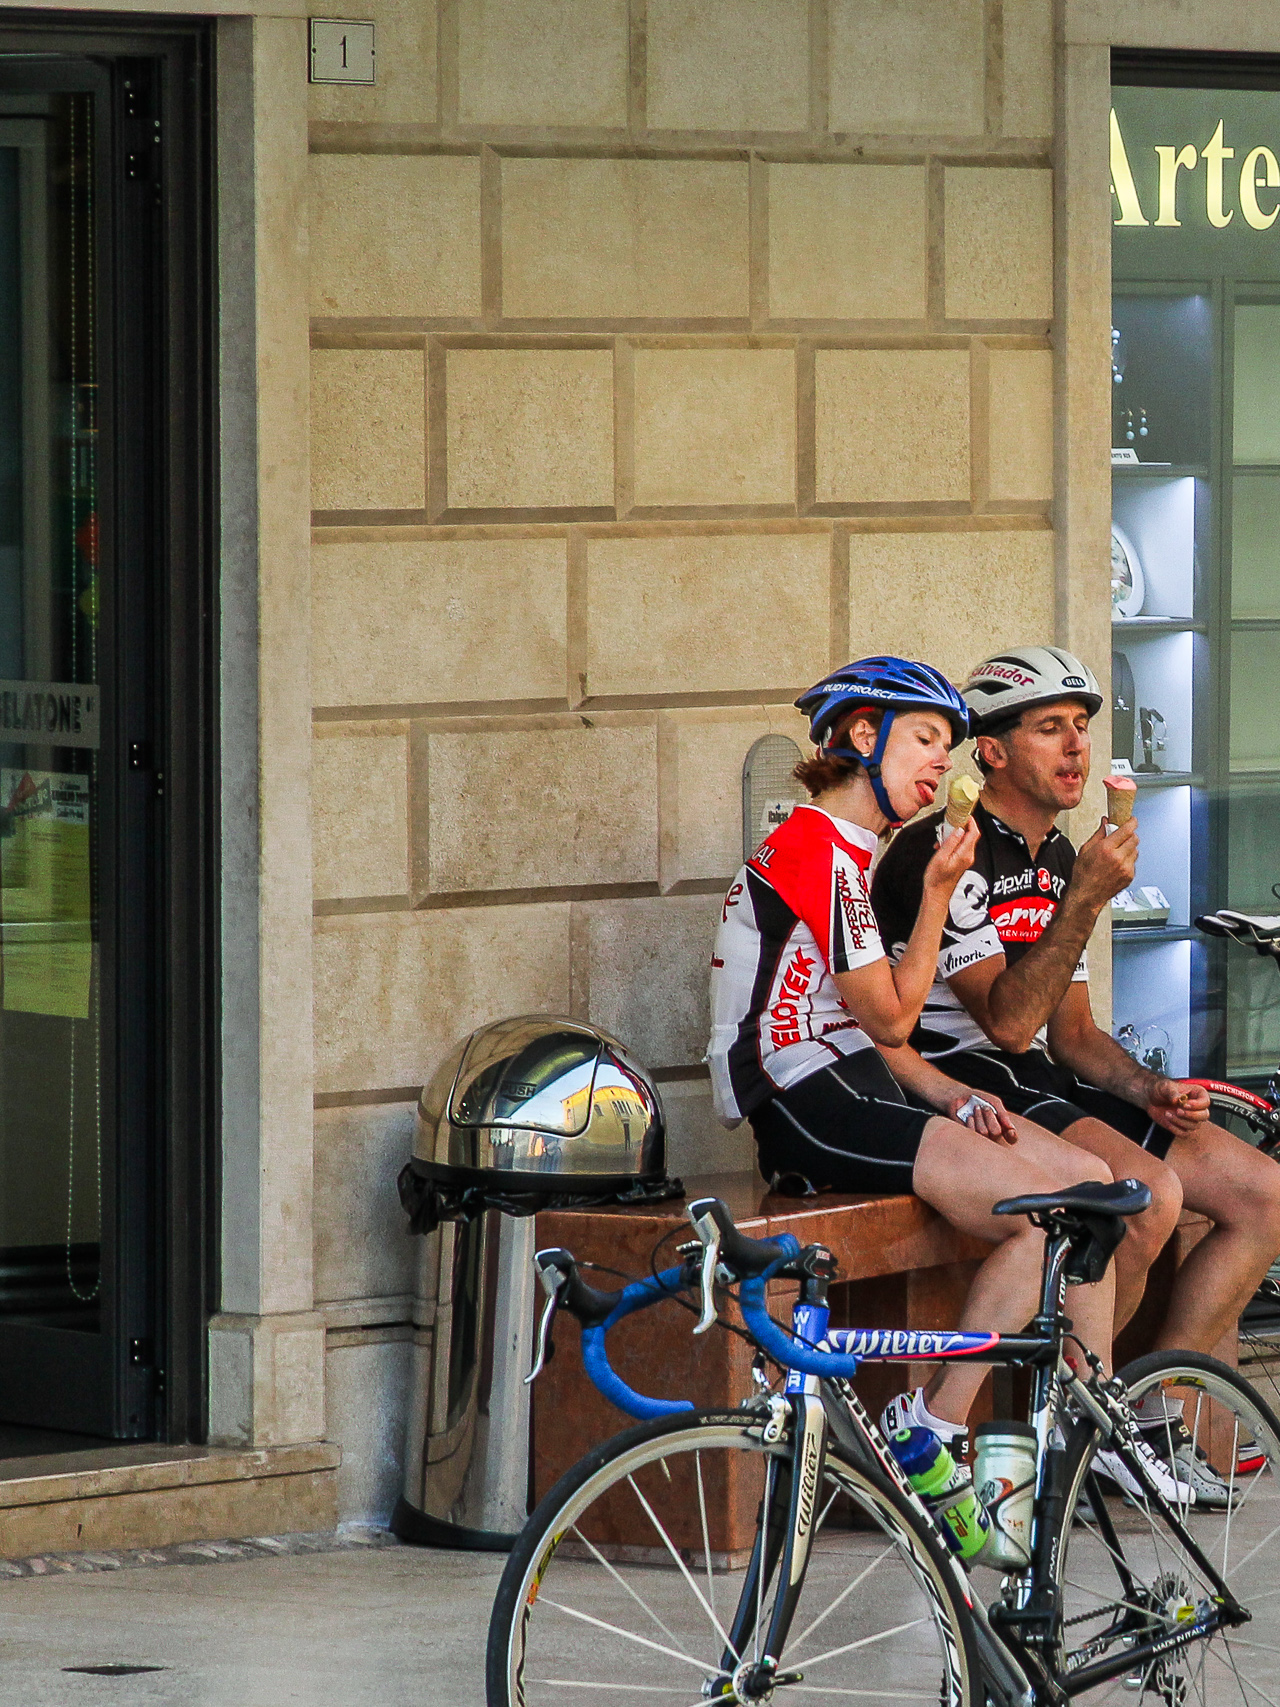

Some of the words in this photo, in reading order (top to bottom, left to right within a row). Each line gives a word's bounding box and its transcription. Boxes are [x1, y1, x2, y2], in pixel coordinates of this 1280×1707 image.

[339, 35, 348, 68] 1
[822, 683, 849, 693] RUDY
[848, 684, 898, 700] PROJECT
[1065, 677, 1085, 686] BELL
[993, 868, 1036, 895] zipvit
[827, 1329, 964, 1355] Wilier
[798, 1432, 817, 1536] Wilier
[1152, 1637, 1176, 1654] MADE
[1184, 1624, 1207, 1641] ITALY
